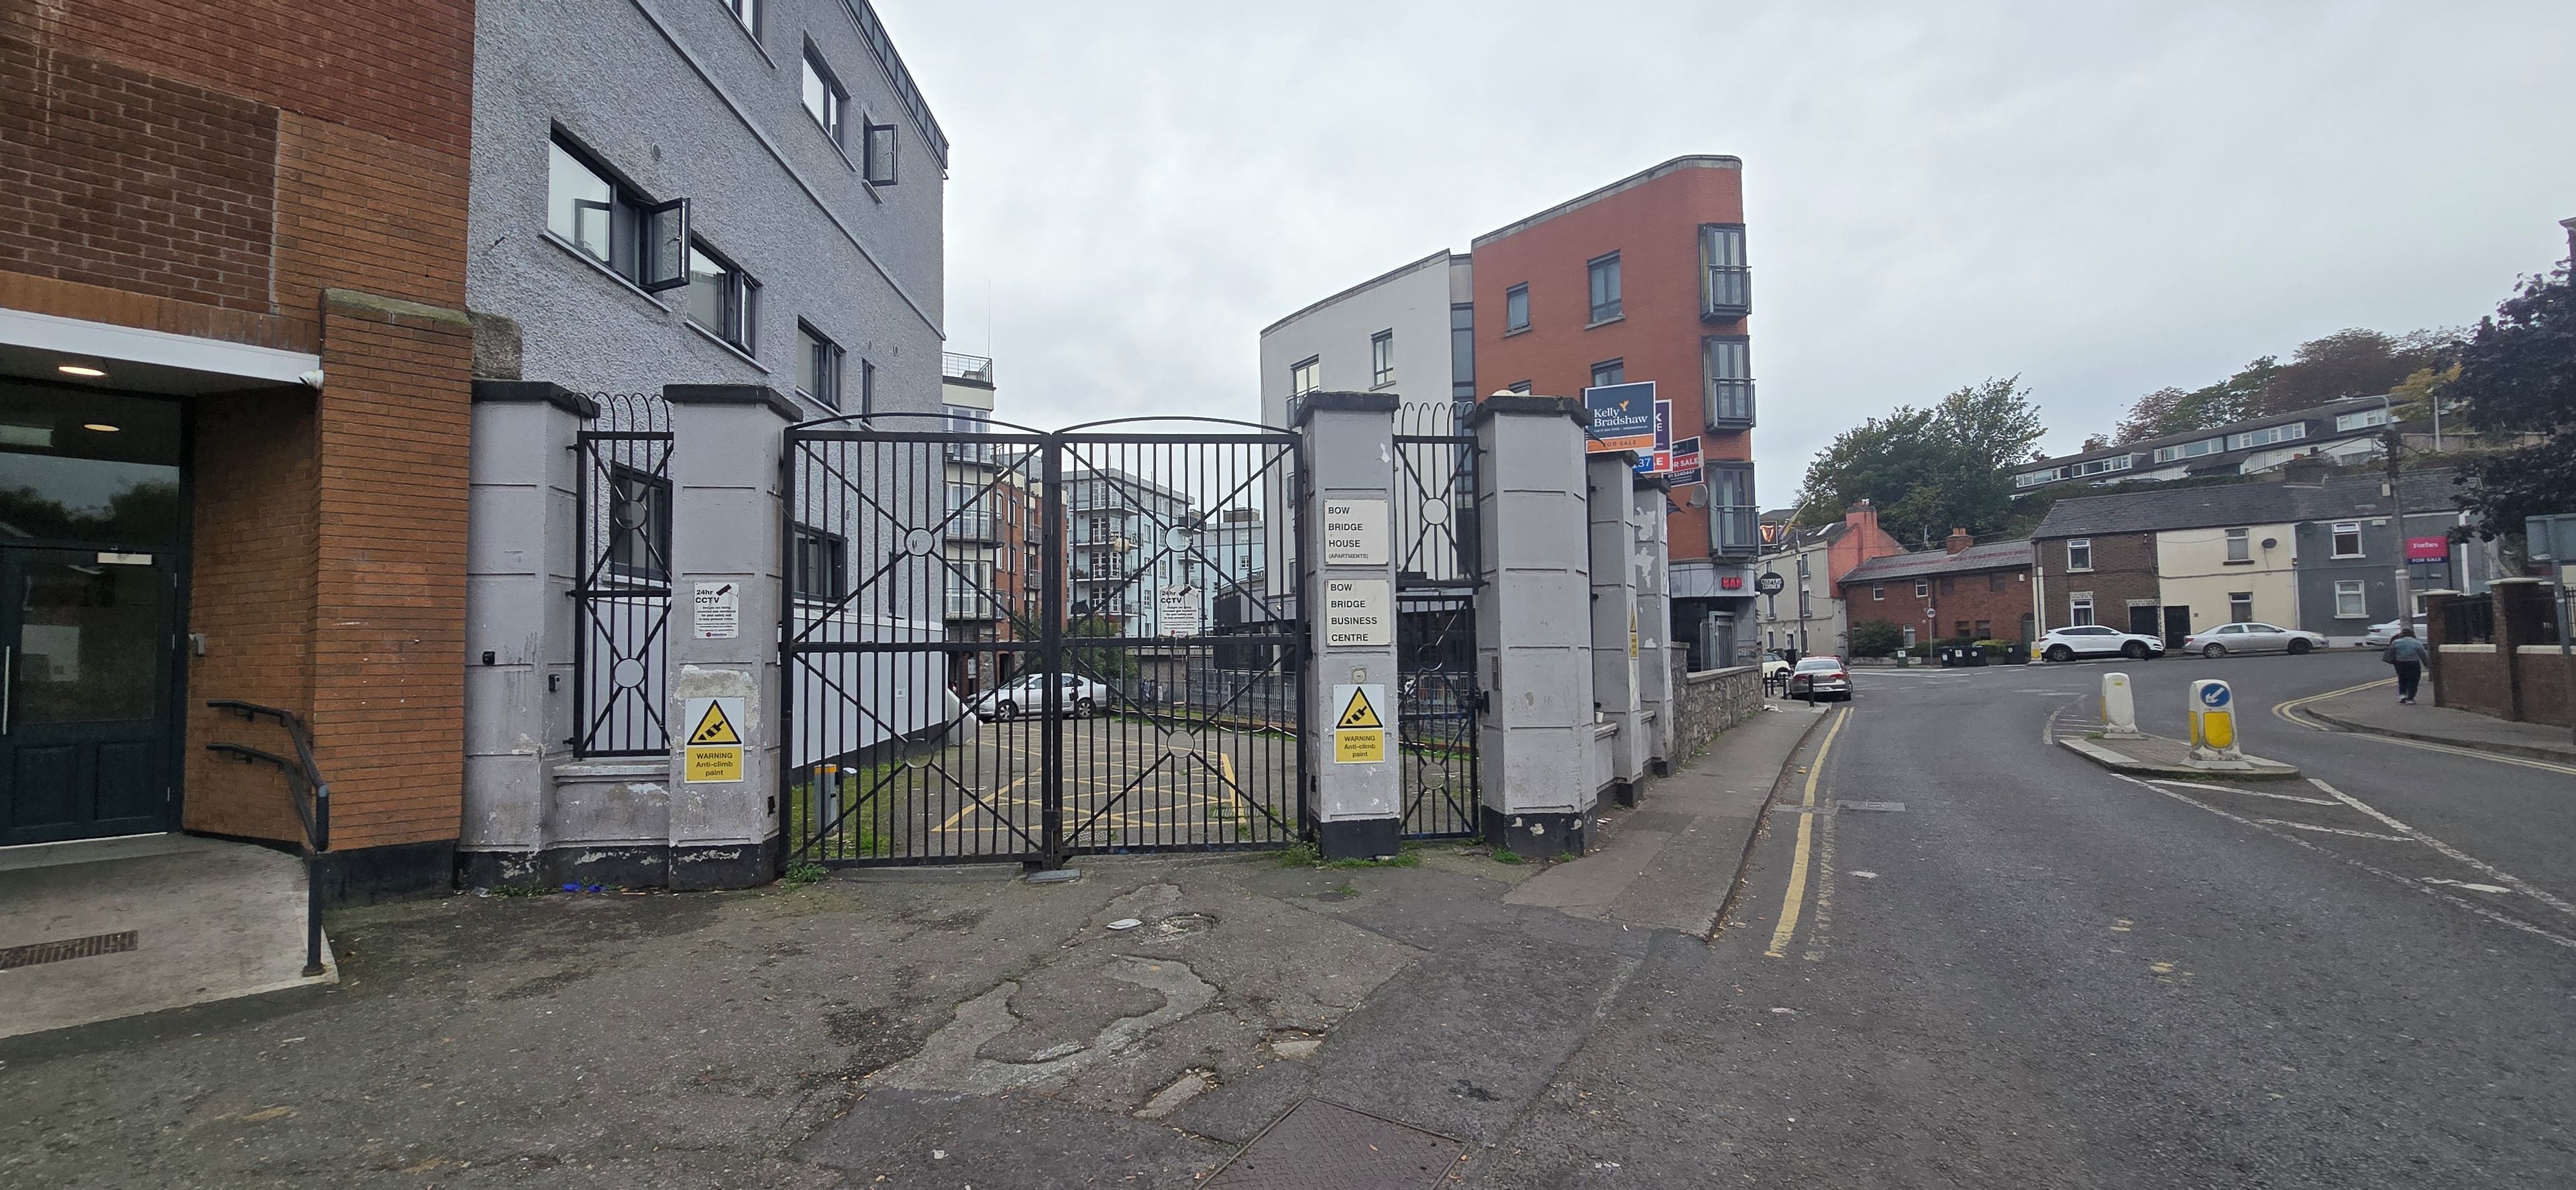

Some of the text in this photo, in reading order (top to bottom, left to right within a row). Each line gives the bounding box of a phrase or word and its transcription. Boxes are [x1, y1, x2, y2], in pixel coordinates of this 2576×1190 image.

[1594, 408, 1619, 418] Kelly
[1594, 416, 1648, 427] Bradshaw
[1680, 457, 1699, 466] SALE
